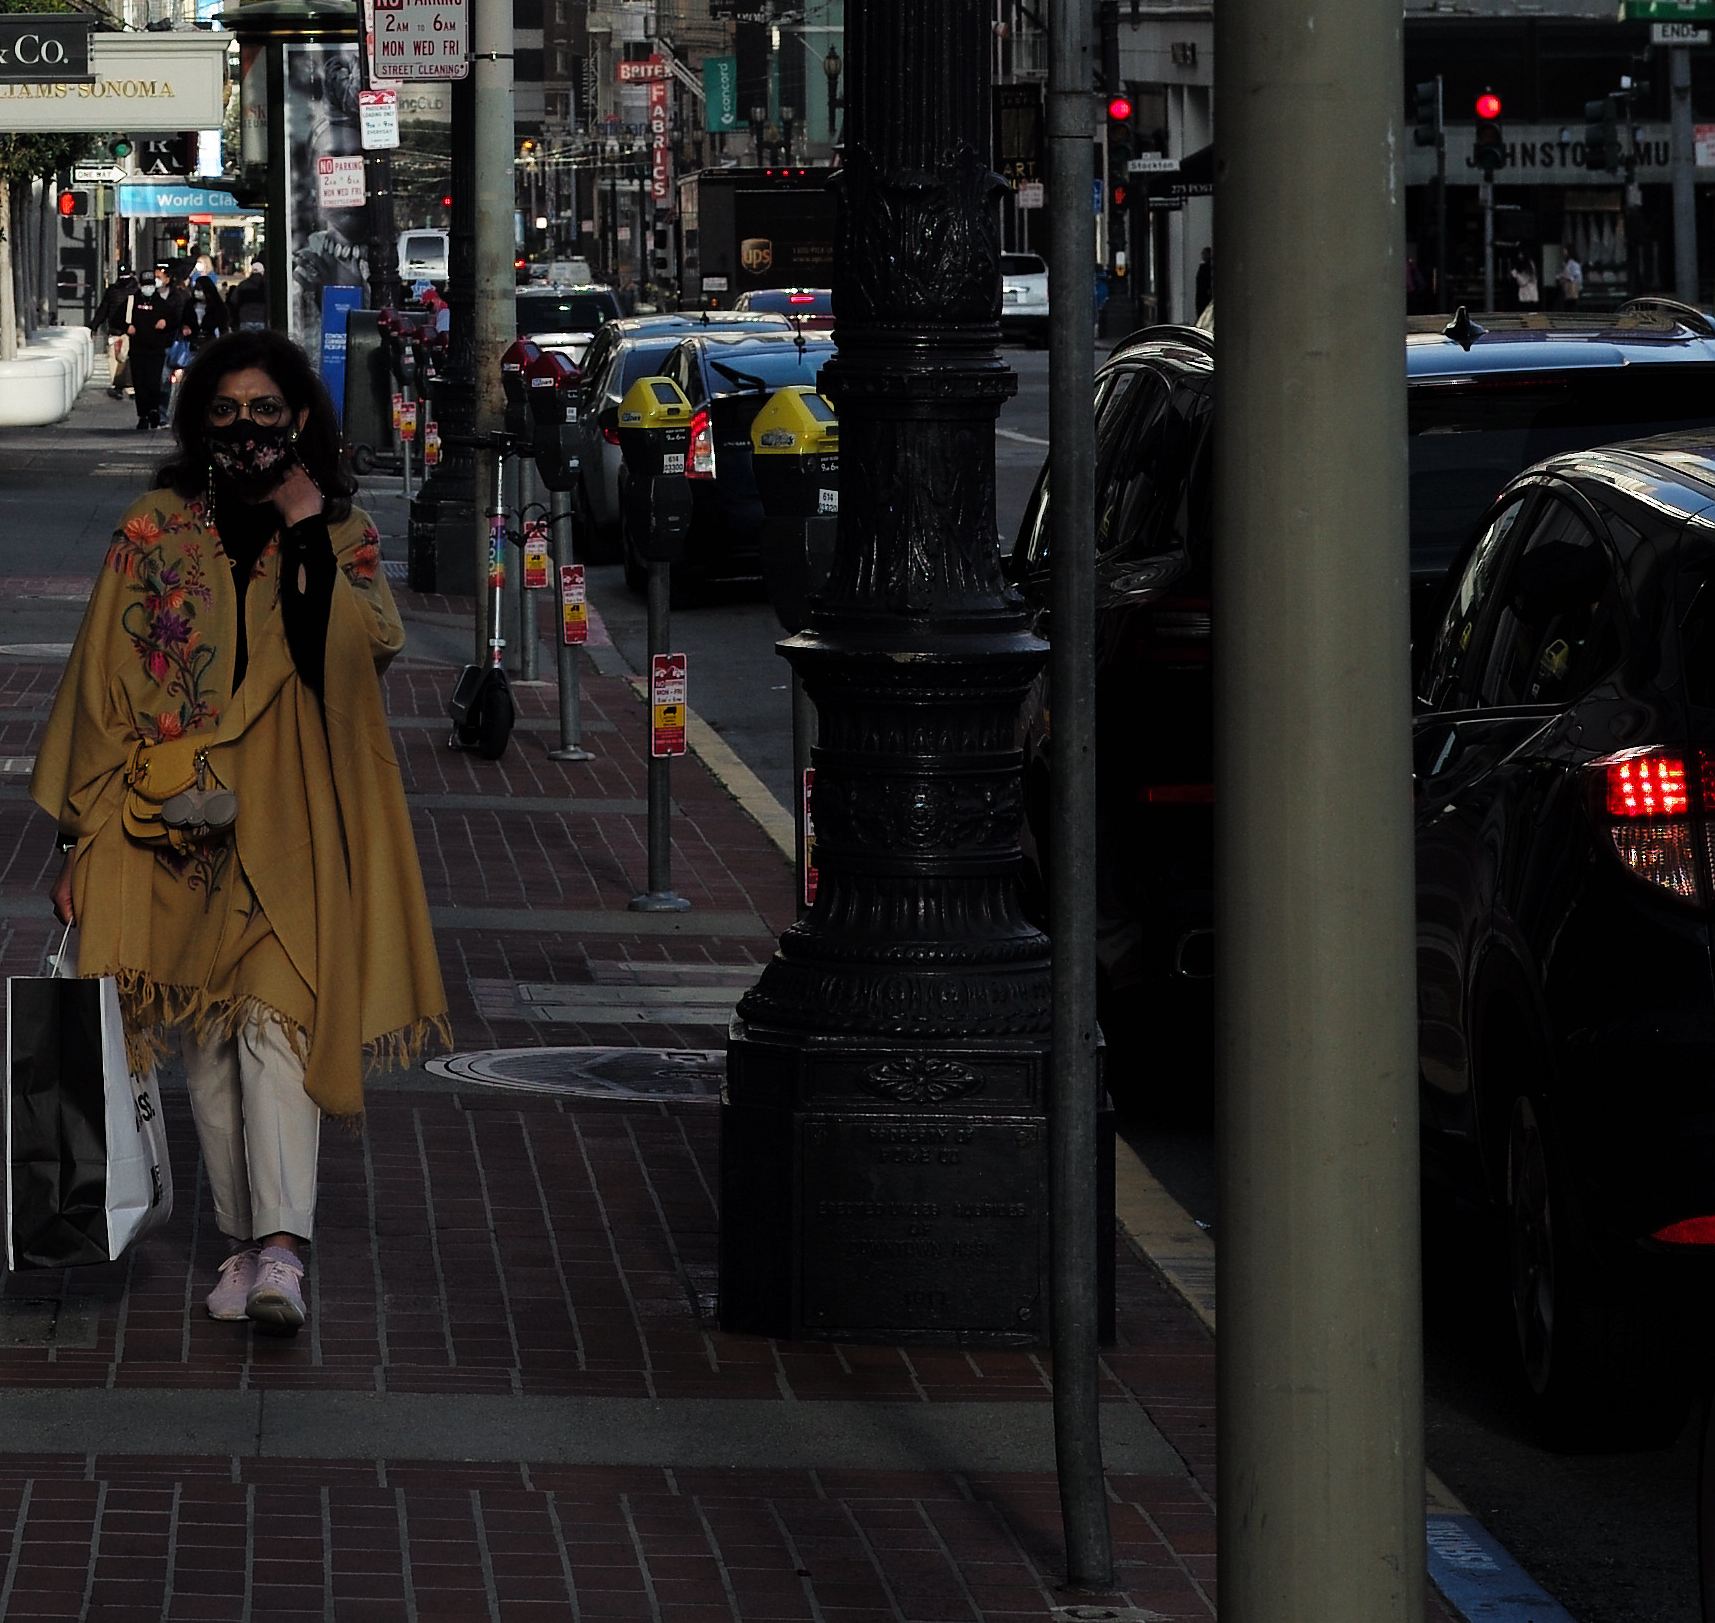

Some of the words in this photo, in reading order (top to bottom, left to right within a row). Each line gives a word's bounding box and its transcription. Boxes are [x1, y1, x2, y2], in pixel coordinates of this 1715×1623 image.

[385, 13, 409, 32] 2AM
[417, 24, 425, 32] TO
[433, 13, 456, 32] 6AM
[1661, 25, 1698, 38] ENDS
[14, 34, 70, 65] Co.
[382, 40, 405, 57] MON
[413, 40, 435, 56] WED
[443, 39, 459, 56] FRI
[382, 65, 414, 75] STREET
[418, 64, 460, 75] CLEANING
[721, 62, 735, 112] concord
[652, 84, 667, 196] FABRICS
[320, 159, 333, 174] NO
[335, 160, 363, 173] PARKING
[156, 192, 203, 208] World
[208, 192, 240, 208] Cla
[745, 248, 771, 269] ups
